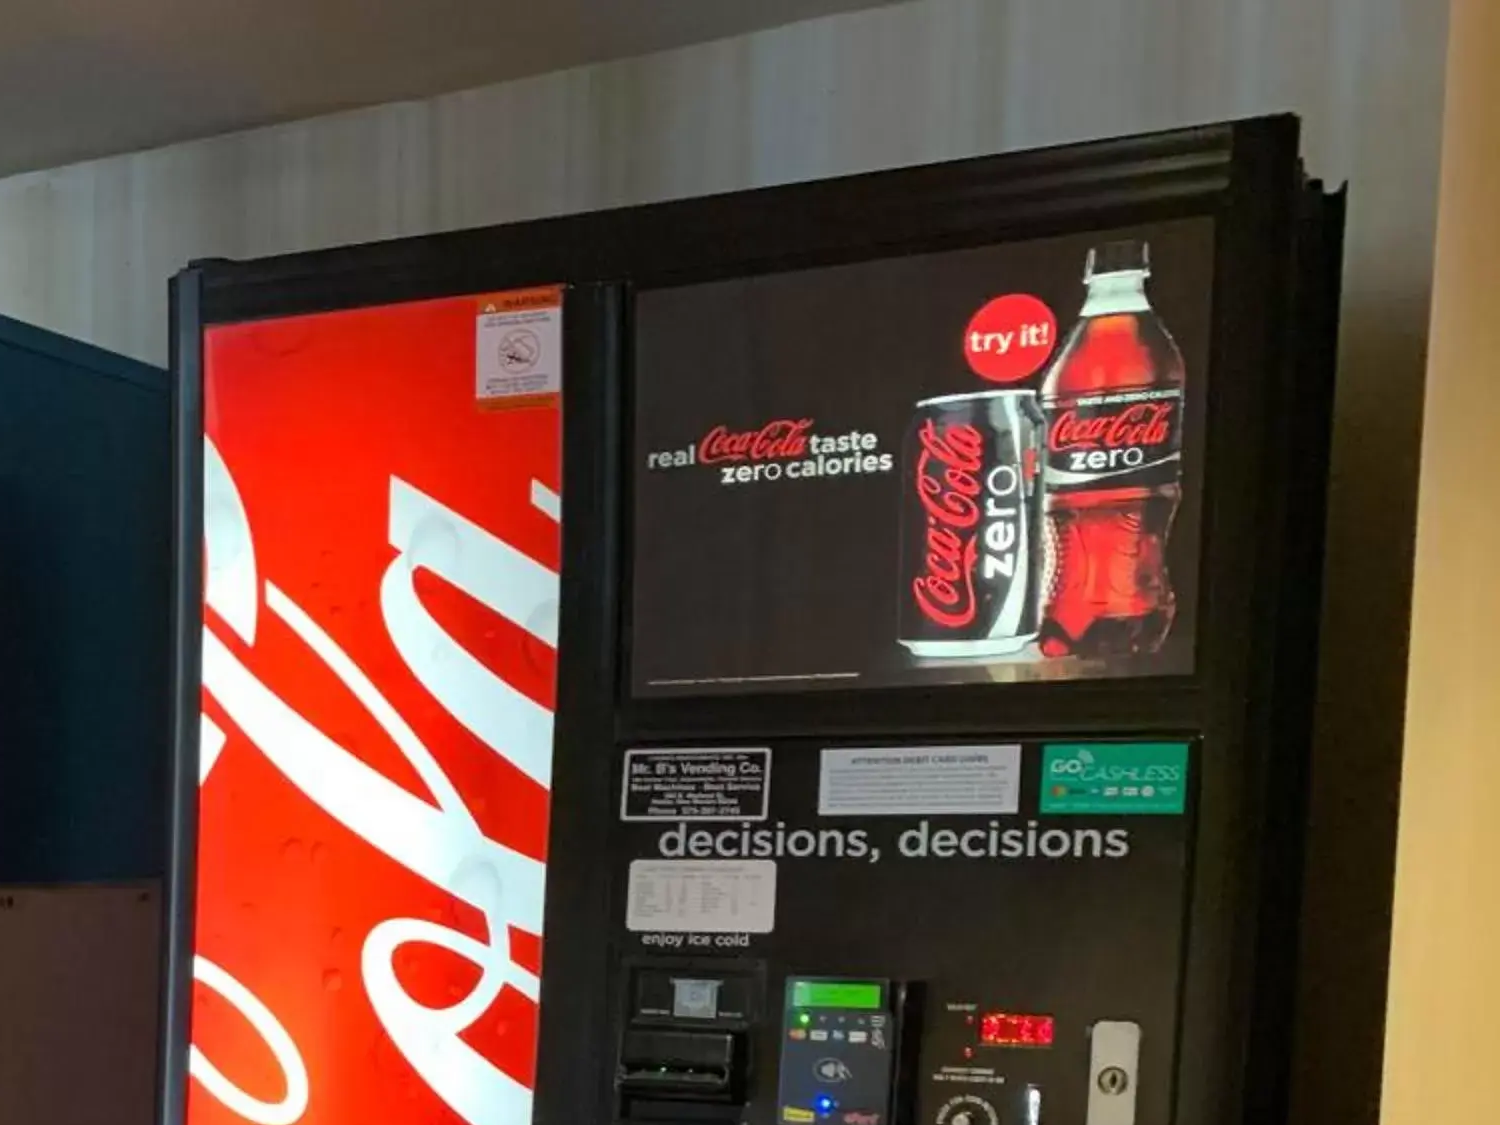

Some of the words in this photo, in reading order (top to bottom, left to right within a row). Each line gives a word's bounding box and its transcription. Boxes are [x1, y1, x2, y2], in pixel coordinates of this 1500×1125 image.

[971, 331, 1014, 355] try
[1020, 321, 1049, 348] it!
[648, 445, 696, 469] real
[700, 418, 814, 465] Coca-Cola
[810, 430, 878, 454] taste
[1049, 402, 1173, 452] Coca-Cola
[721, 463, 782, 485] zero
[786, 453, 894, 479] calories
[1069, 447, 1144, 471] zero
[913, 417, 983, 628] Coca-Cola
[983, 464, 1018, 580] zero
[680, 761, 737, 777] Vending
[1051, 759, 1083, 774] GO
[658, 821, 881, 863] decisions,
[897, 820, 1130, 858] decisions
[641, 933, 684, 948] enjoy
[688, 932, 712, 944] ice
[715, 931, 750, 947] cold
